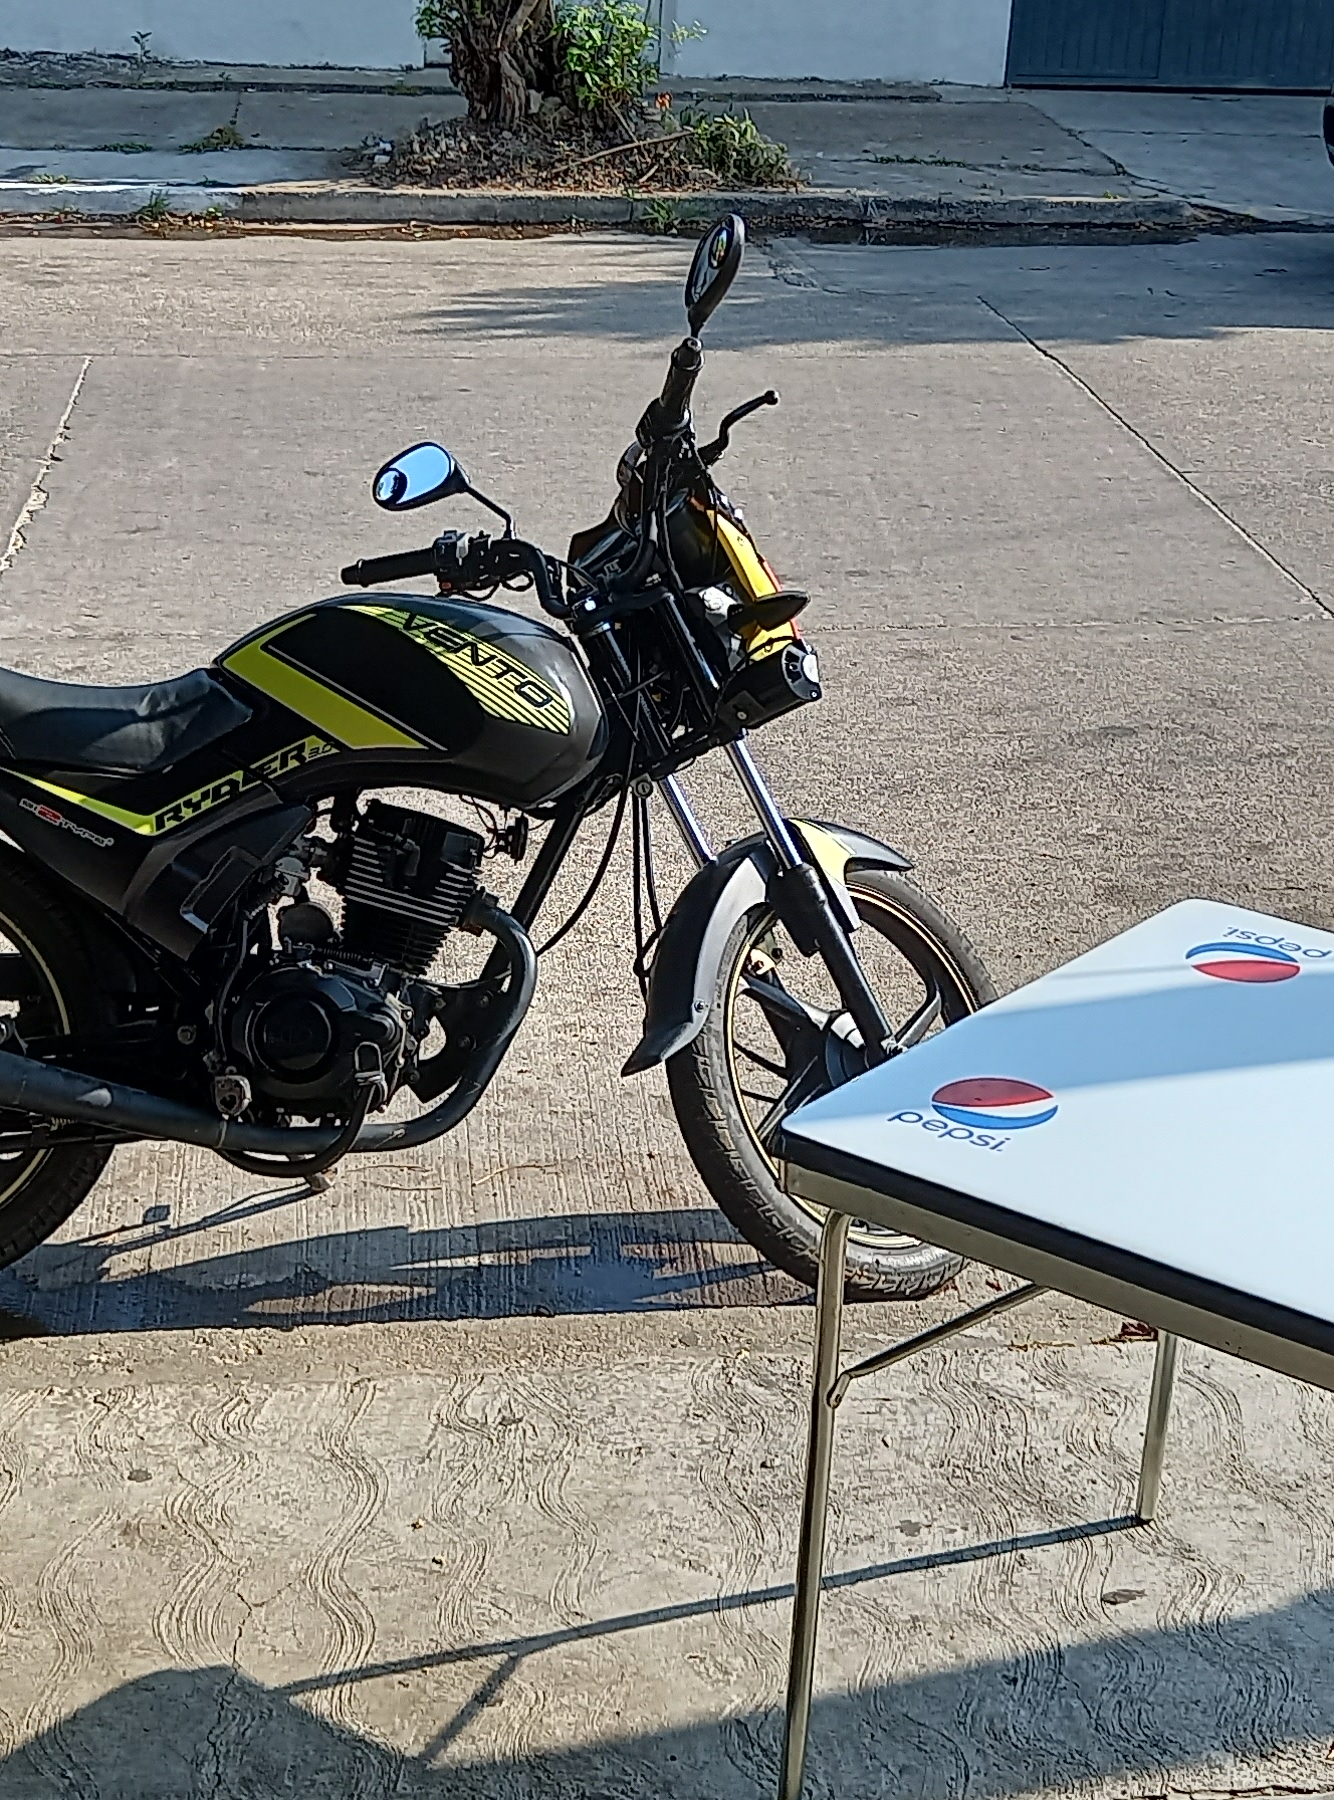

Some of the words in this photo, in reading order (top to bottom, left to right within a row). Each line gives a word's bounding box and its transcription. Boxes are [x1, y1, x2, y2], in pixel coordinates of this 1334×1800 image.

[402, 612, 553, 708] VENTO
[154, 741, 310, 833] RYDER
[1222, 926, 1334, 958] pepsi
[887, 1111, 1011, 1152] pepsi
